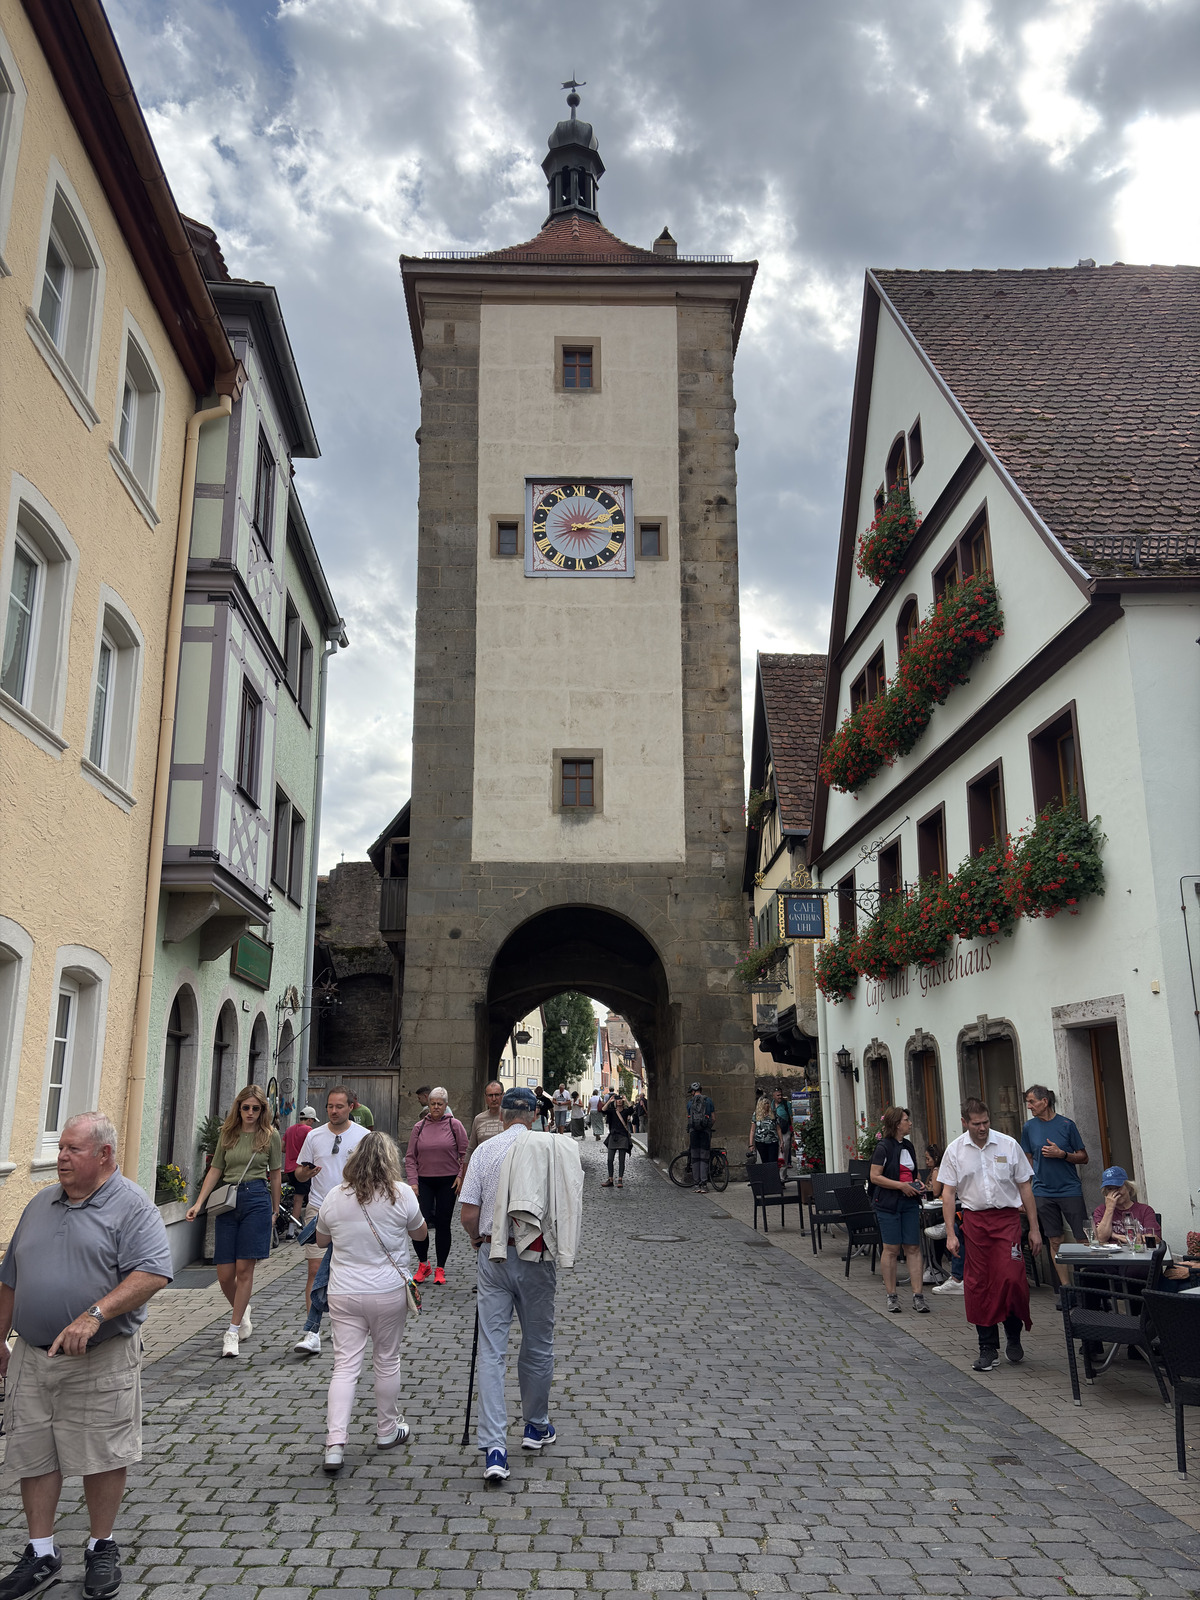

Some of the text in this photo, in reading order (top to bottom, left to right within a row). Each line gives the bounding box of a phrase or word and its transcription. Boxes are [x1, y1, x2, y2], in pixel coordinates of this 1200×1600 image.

[551, 488, 567, 502] XI
[572, 485, 586, 496] XII
[595, 490, 603, 501] I
[537, 503, 552, 514] X
[607, 504, 620, 514] II
[533, 521, 546, 533] IX
[536, 538, 551, 554] VIII
[551, 551, 566, 567] VII
[575, 558, 586, 570] VI
[596, 555, 606, 566] V
